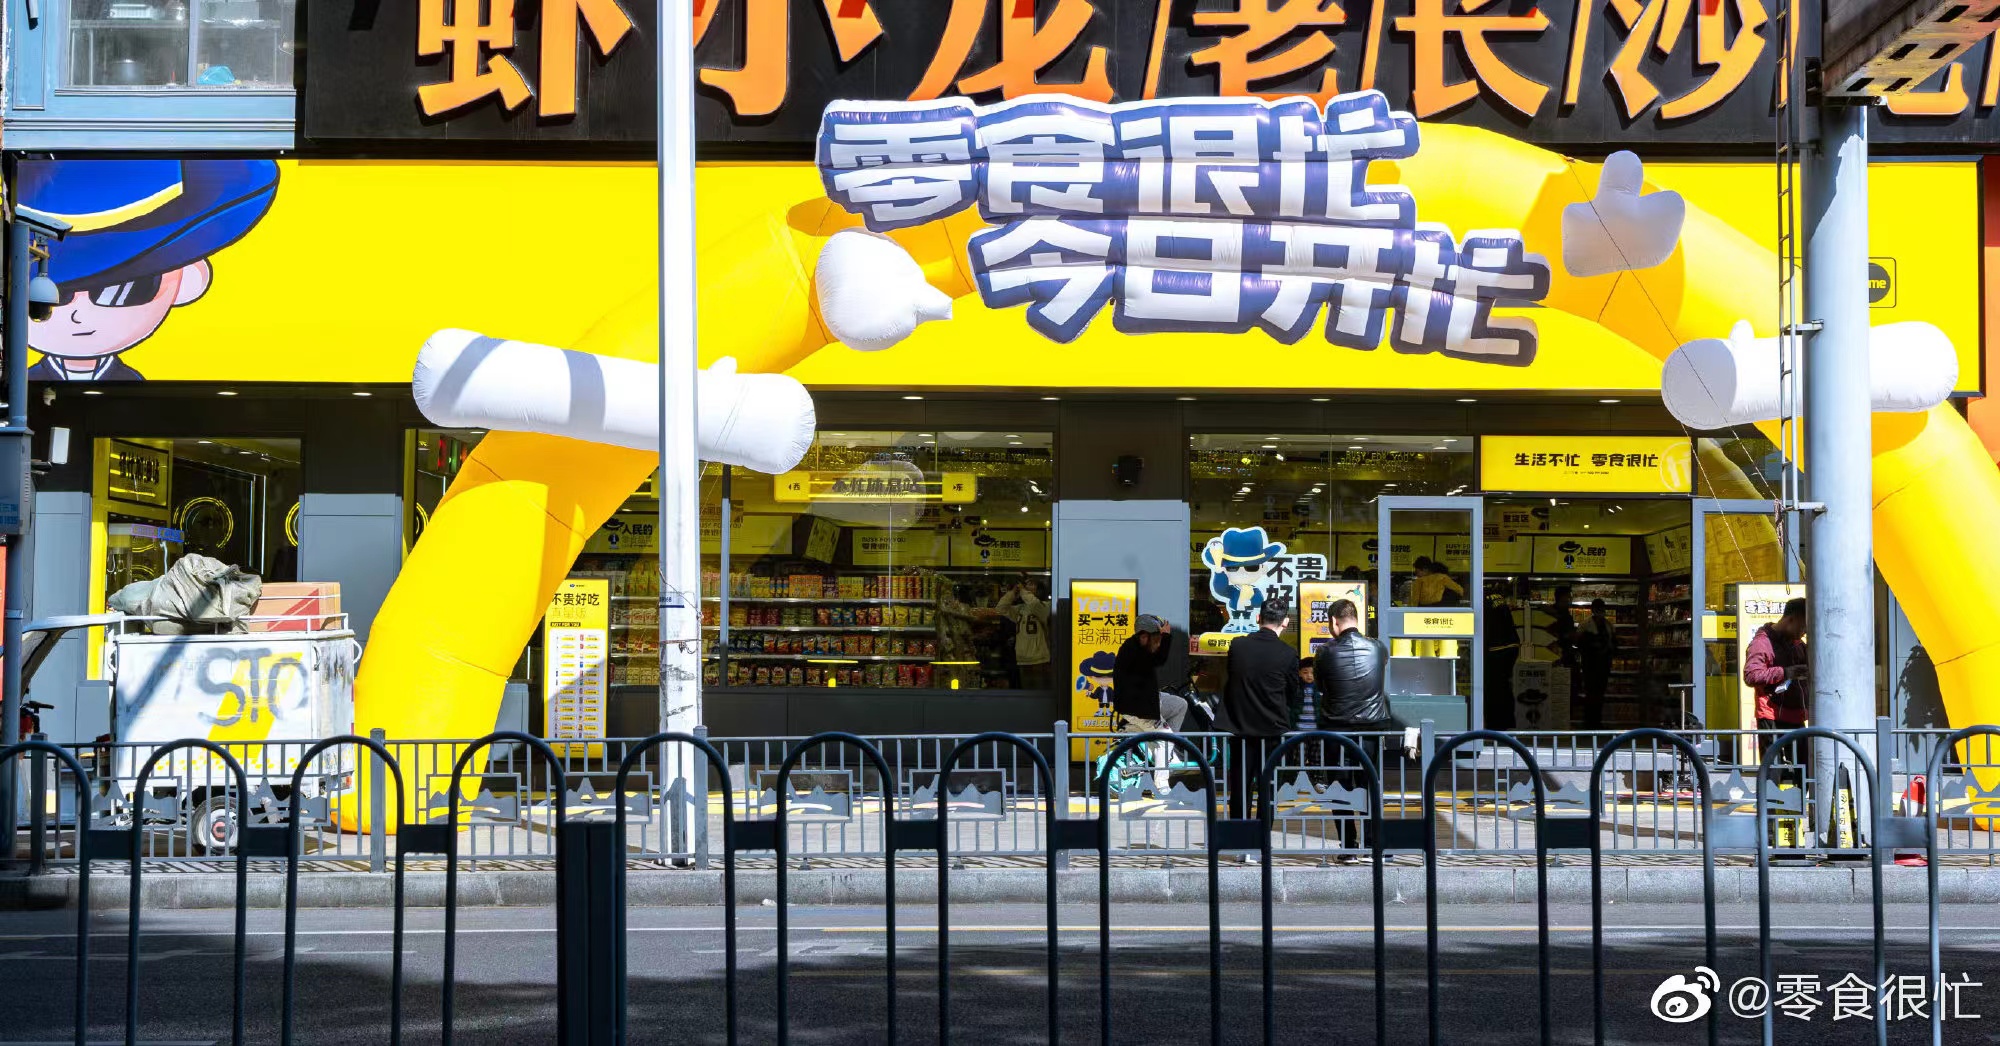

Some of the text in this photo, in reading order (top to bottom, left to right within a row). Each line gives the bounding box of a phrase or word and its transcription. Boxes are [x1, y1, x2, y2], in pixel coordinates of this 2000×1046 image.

[822, 97, 1418, 222] 零食很忙
[972, 215, 1548, 364] 今日开忙
[1515, 453, 1659, 468] 生活不忙 零食很忙
[622, 524, 652, 535] 人民的
[1577, 547, 1607, 557] 人民的
[1266, 557, 1323, 583] 不贵
[551, 593, 600, 606] 不贵好吃
[1266, 585, 1299, 607] 好
[1078, 597, 1130, 612] Yeah!
[1078, 614, 1129, 626] 买一大袋
[1078, 627, 1127, 645] 超满足
[196, 645, 310, 727] STO
